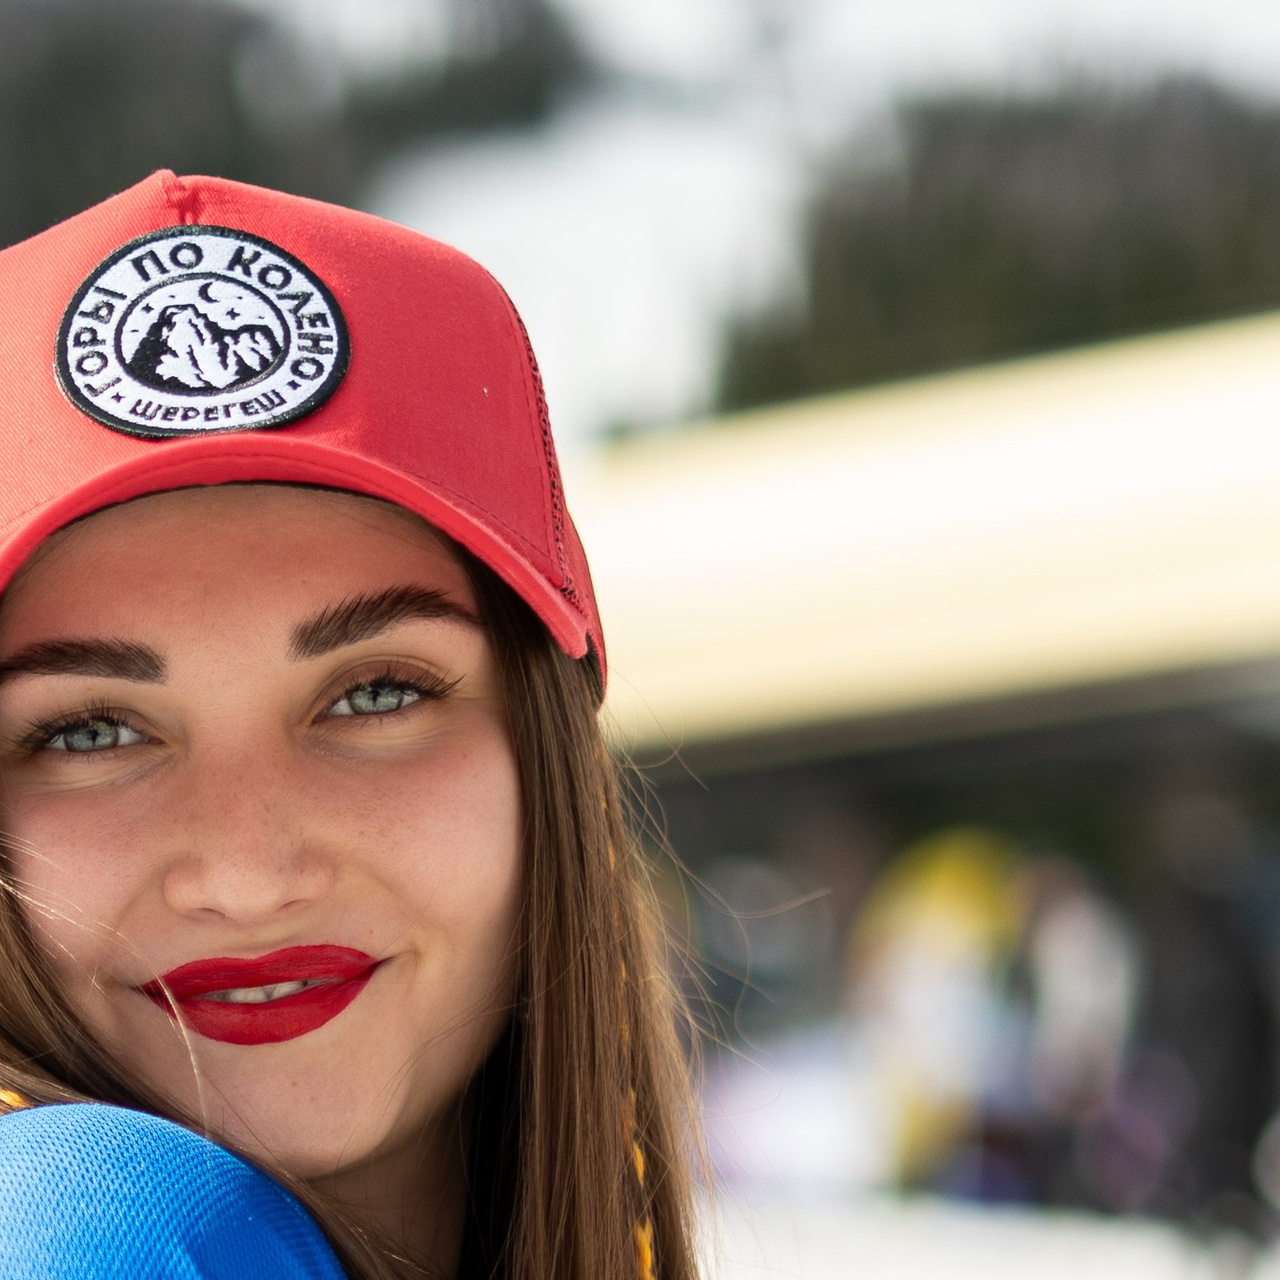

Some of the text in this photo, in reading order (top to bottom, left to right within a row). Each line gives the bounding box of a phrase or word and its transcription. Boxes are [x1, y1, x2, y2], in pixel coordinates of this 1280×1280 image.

[73, 242, 334, 396] ГОРЫ ПО КОЛЕНО
[129, 389, 287, 421] ШЕРЕГЕШ
